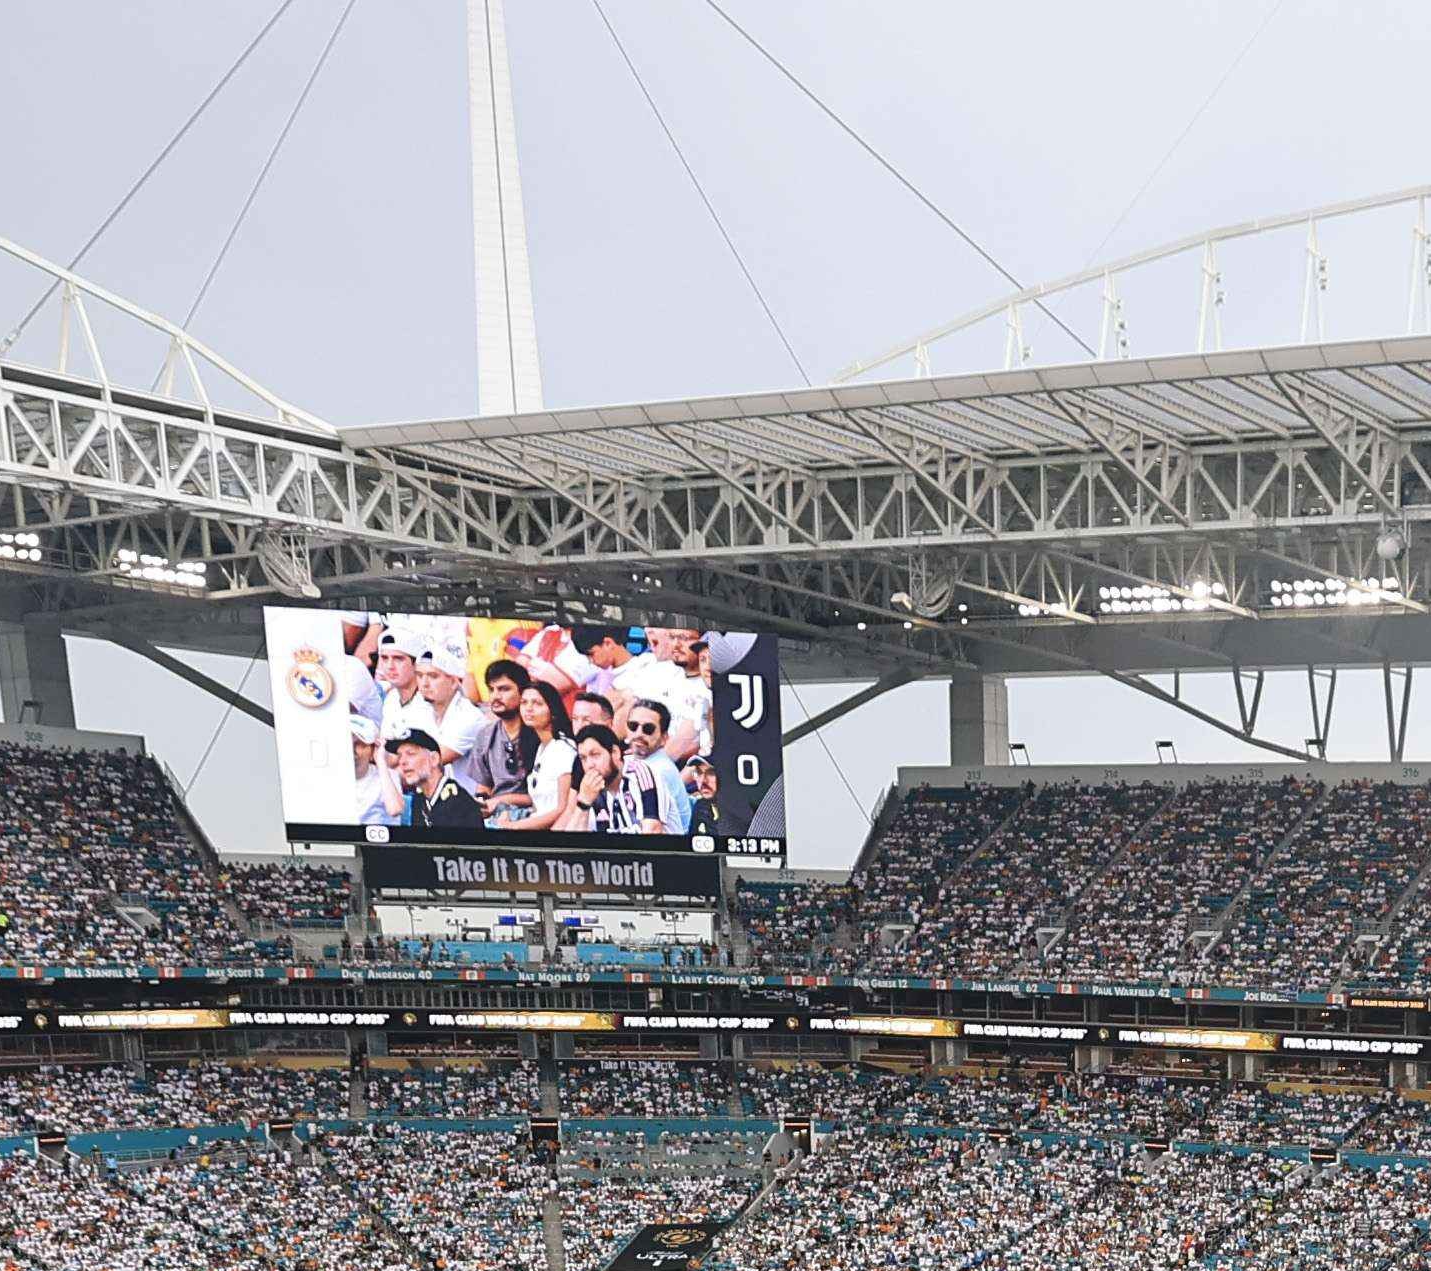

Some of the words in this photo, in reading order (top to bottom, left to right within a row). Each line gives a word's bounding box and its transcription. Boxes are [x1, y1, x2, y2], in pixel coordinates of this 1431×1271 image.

[737, 754, 760, 785] 0
[727, 838, 758, 853] 3:13
[760, 839, 780, 853] PM
[433, 856, 486, 882] Take
[492, 857, 509, 882] It
[514, 859, 540, 883] To
[545, 859, 584, 884] The
[590, 861, 654, 886] World
[671, 975, 701, 984] LARRY
[751, 976, 765, 985] 39
